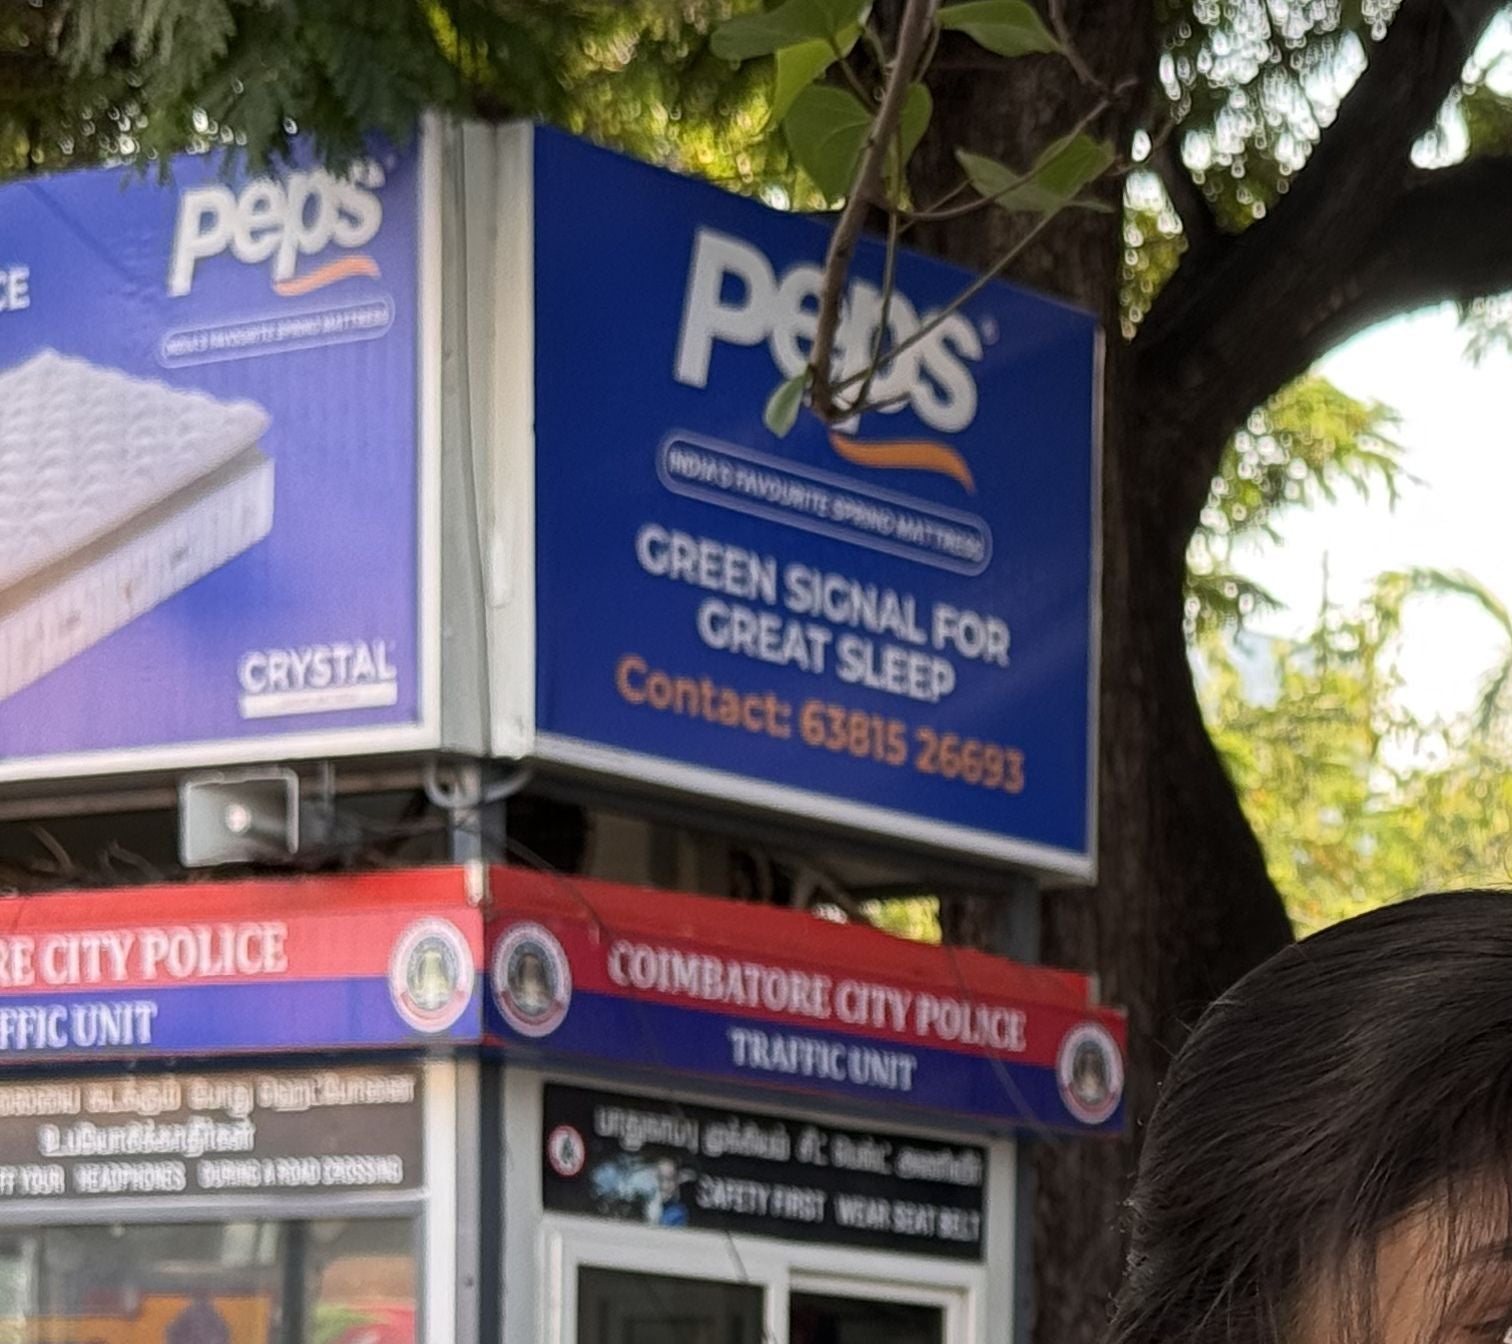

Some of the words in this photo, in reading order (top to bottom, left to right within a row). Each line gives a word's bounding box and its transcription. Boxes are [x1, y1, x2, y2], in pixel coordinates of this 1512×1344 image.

[166, 160, 386, 297] peps
[673, 226, 983, 434] peps
[635, 523, 777, 606] GREEN
[784, 562, 928, 645] SIGNAL
[931, 602, 1011, 668] FOR
[237, 639, 397, 694] CRYSTAL
[697, 598, 832, 675] GREAT
[835, 632, 956, 703] SLEEP
[615, 653, 791, 740] Contact:
[800, 698, 908, 768] 63815
[914, 726, 1027, 795] 26693
[39, 929, 136, 985] CITY
[136, 921, 289, 981] POLICE
[607, 938, 833, 1020] COIMBATORE
[834, 977, 913, 1034] CITY
[912, 993, 1028, 1053] POLICE
[71, 1000, 158, 1048] UNIT
[727, 1025, 846, 1082] TRAFFIC
[846, 1044, 918, 1092] UNIT
[73, 1160, 187, 1194] HEADPHONES
[697, 1172, 771, 1217] SAFETY
[770, 1183, 827, 1224] FIRST
[833, 1191, 892, 1231] WEAR
